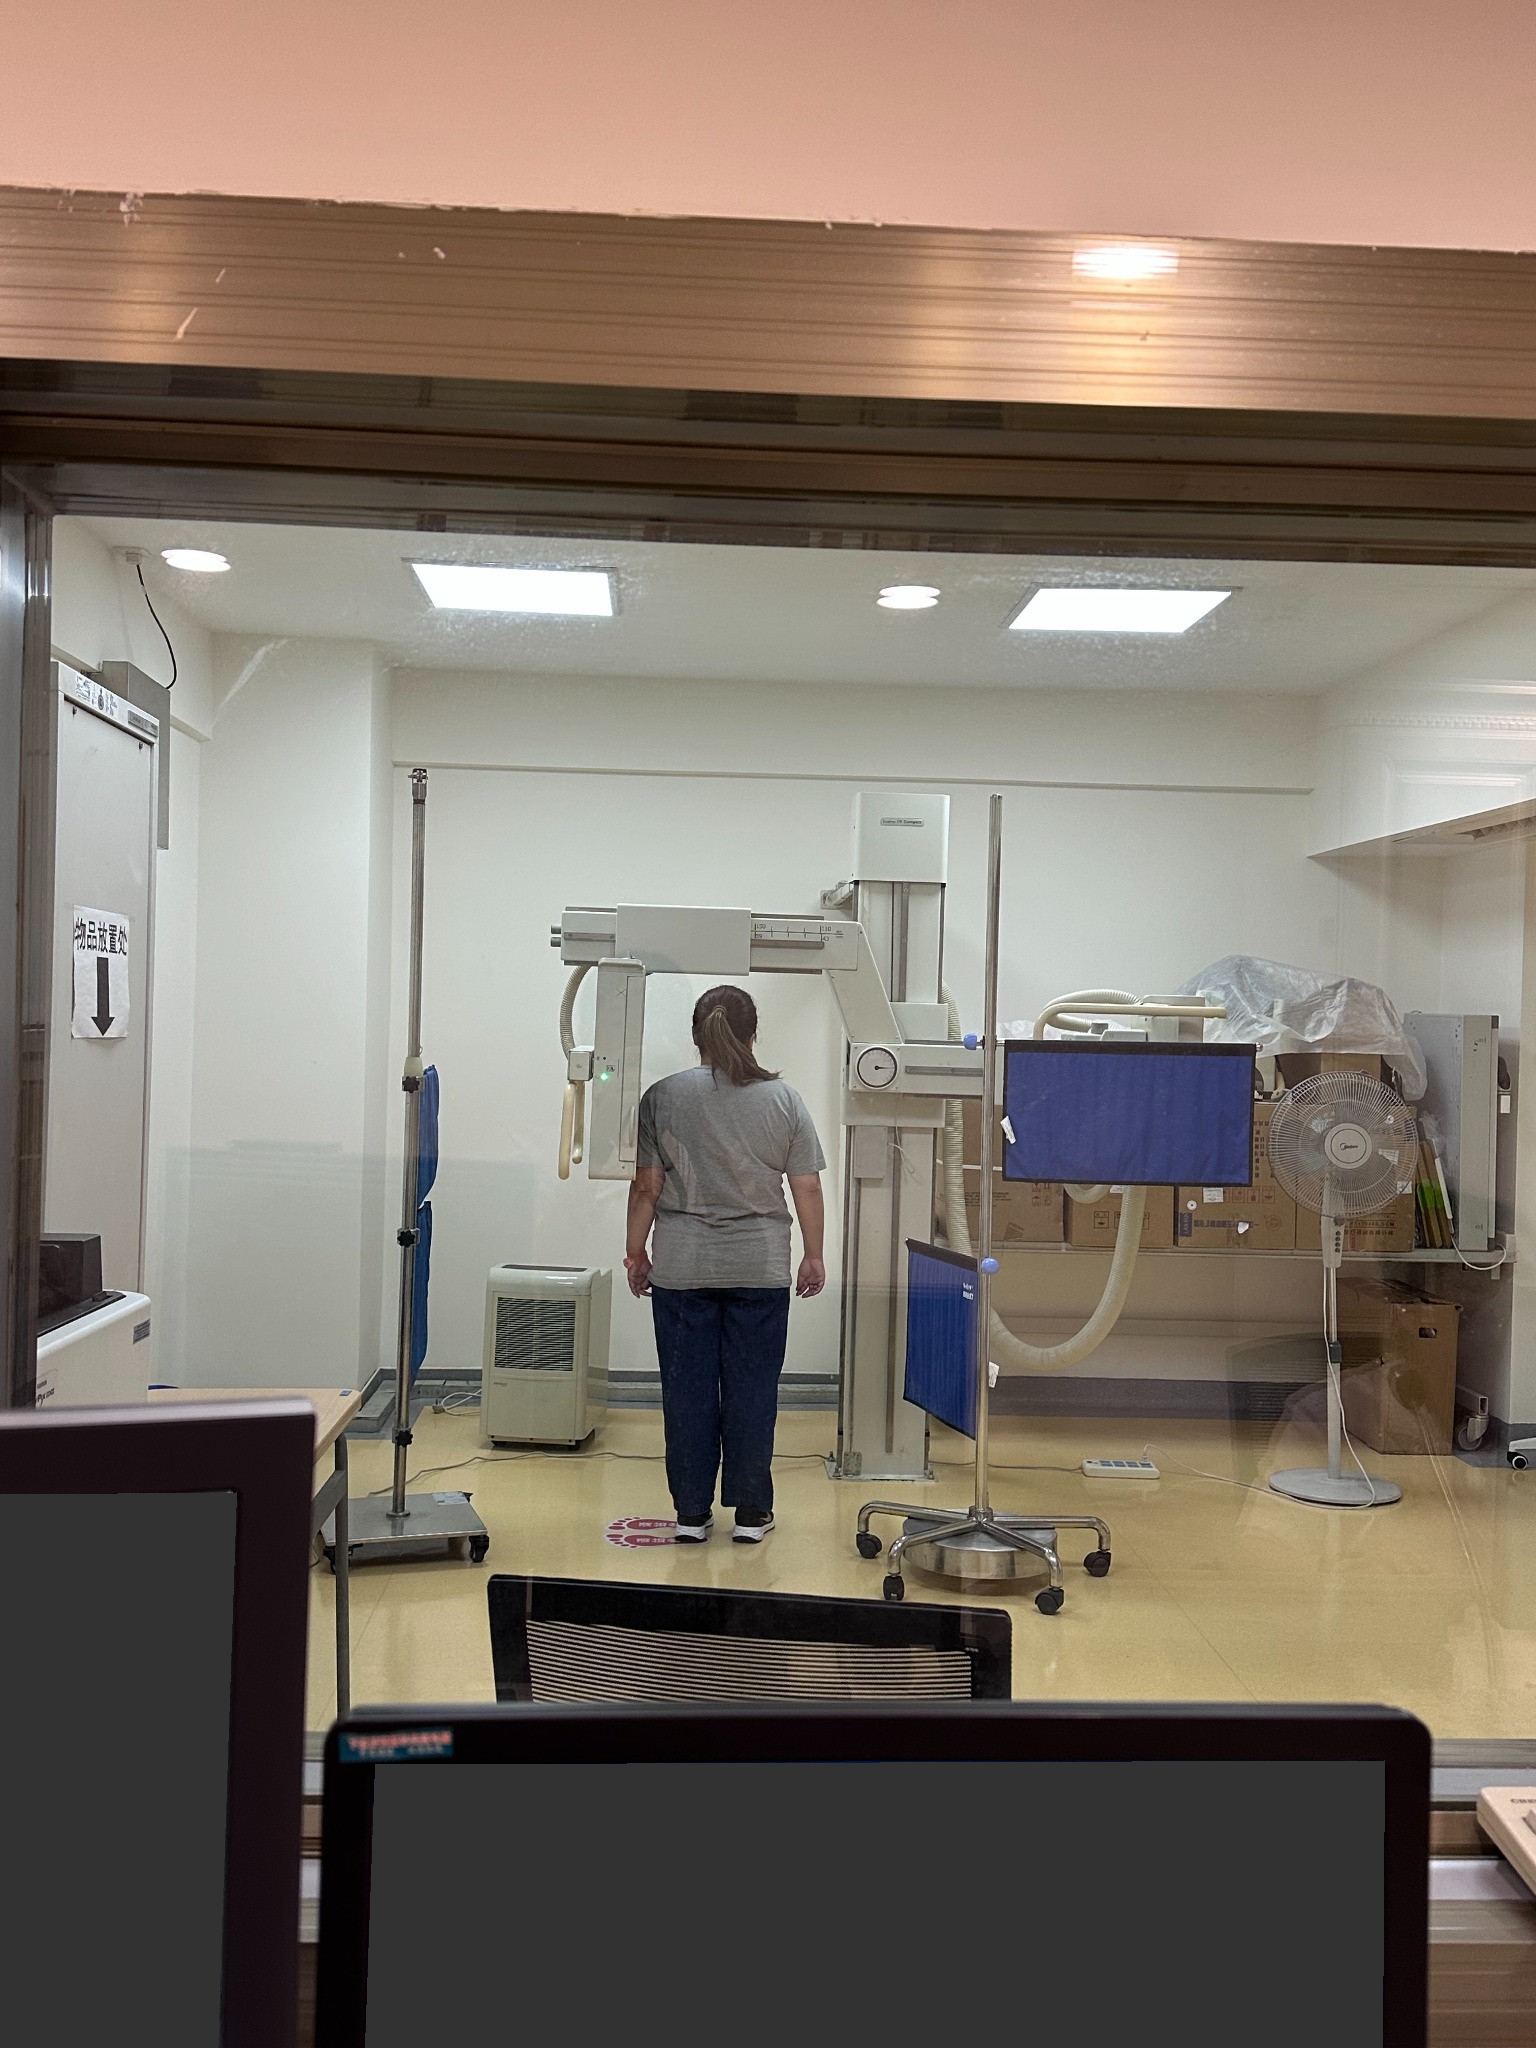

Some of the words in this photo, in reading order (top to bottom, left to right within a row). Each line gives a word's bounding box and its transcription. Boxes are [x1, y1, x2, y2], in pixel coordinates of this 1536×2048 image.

[74, 917, 128, 957] 物品放置处
